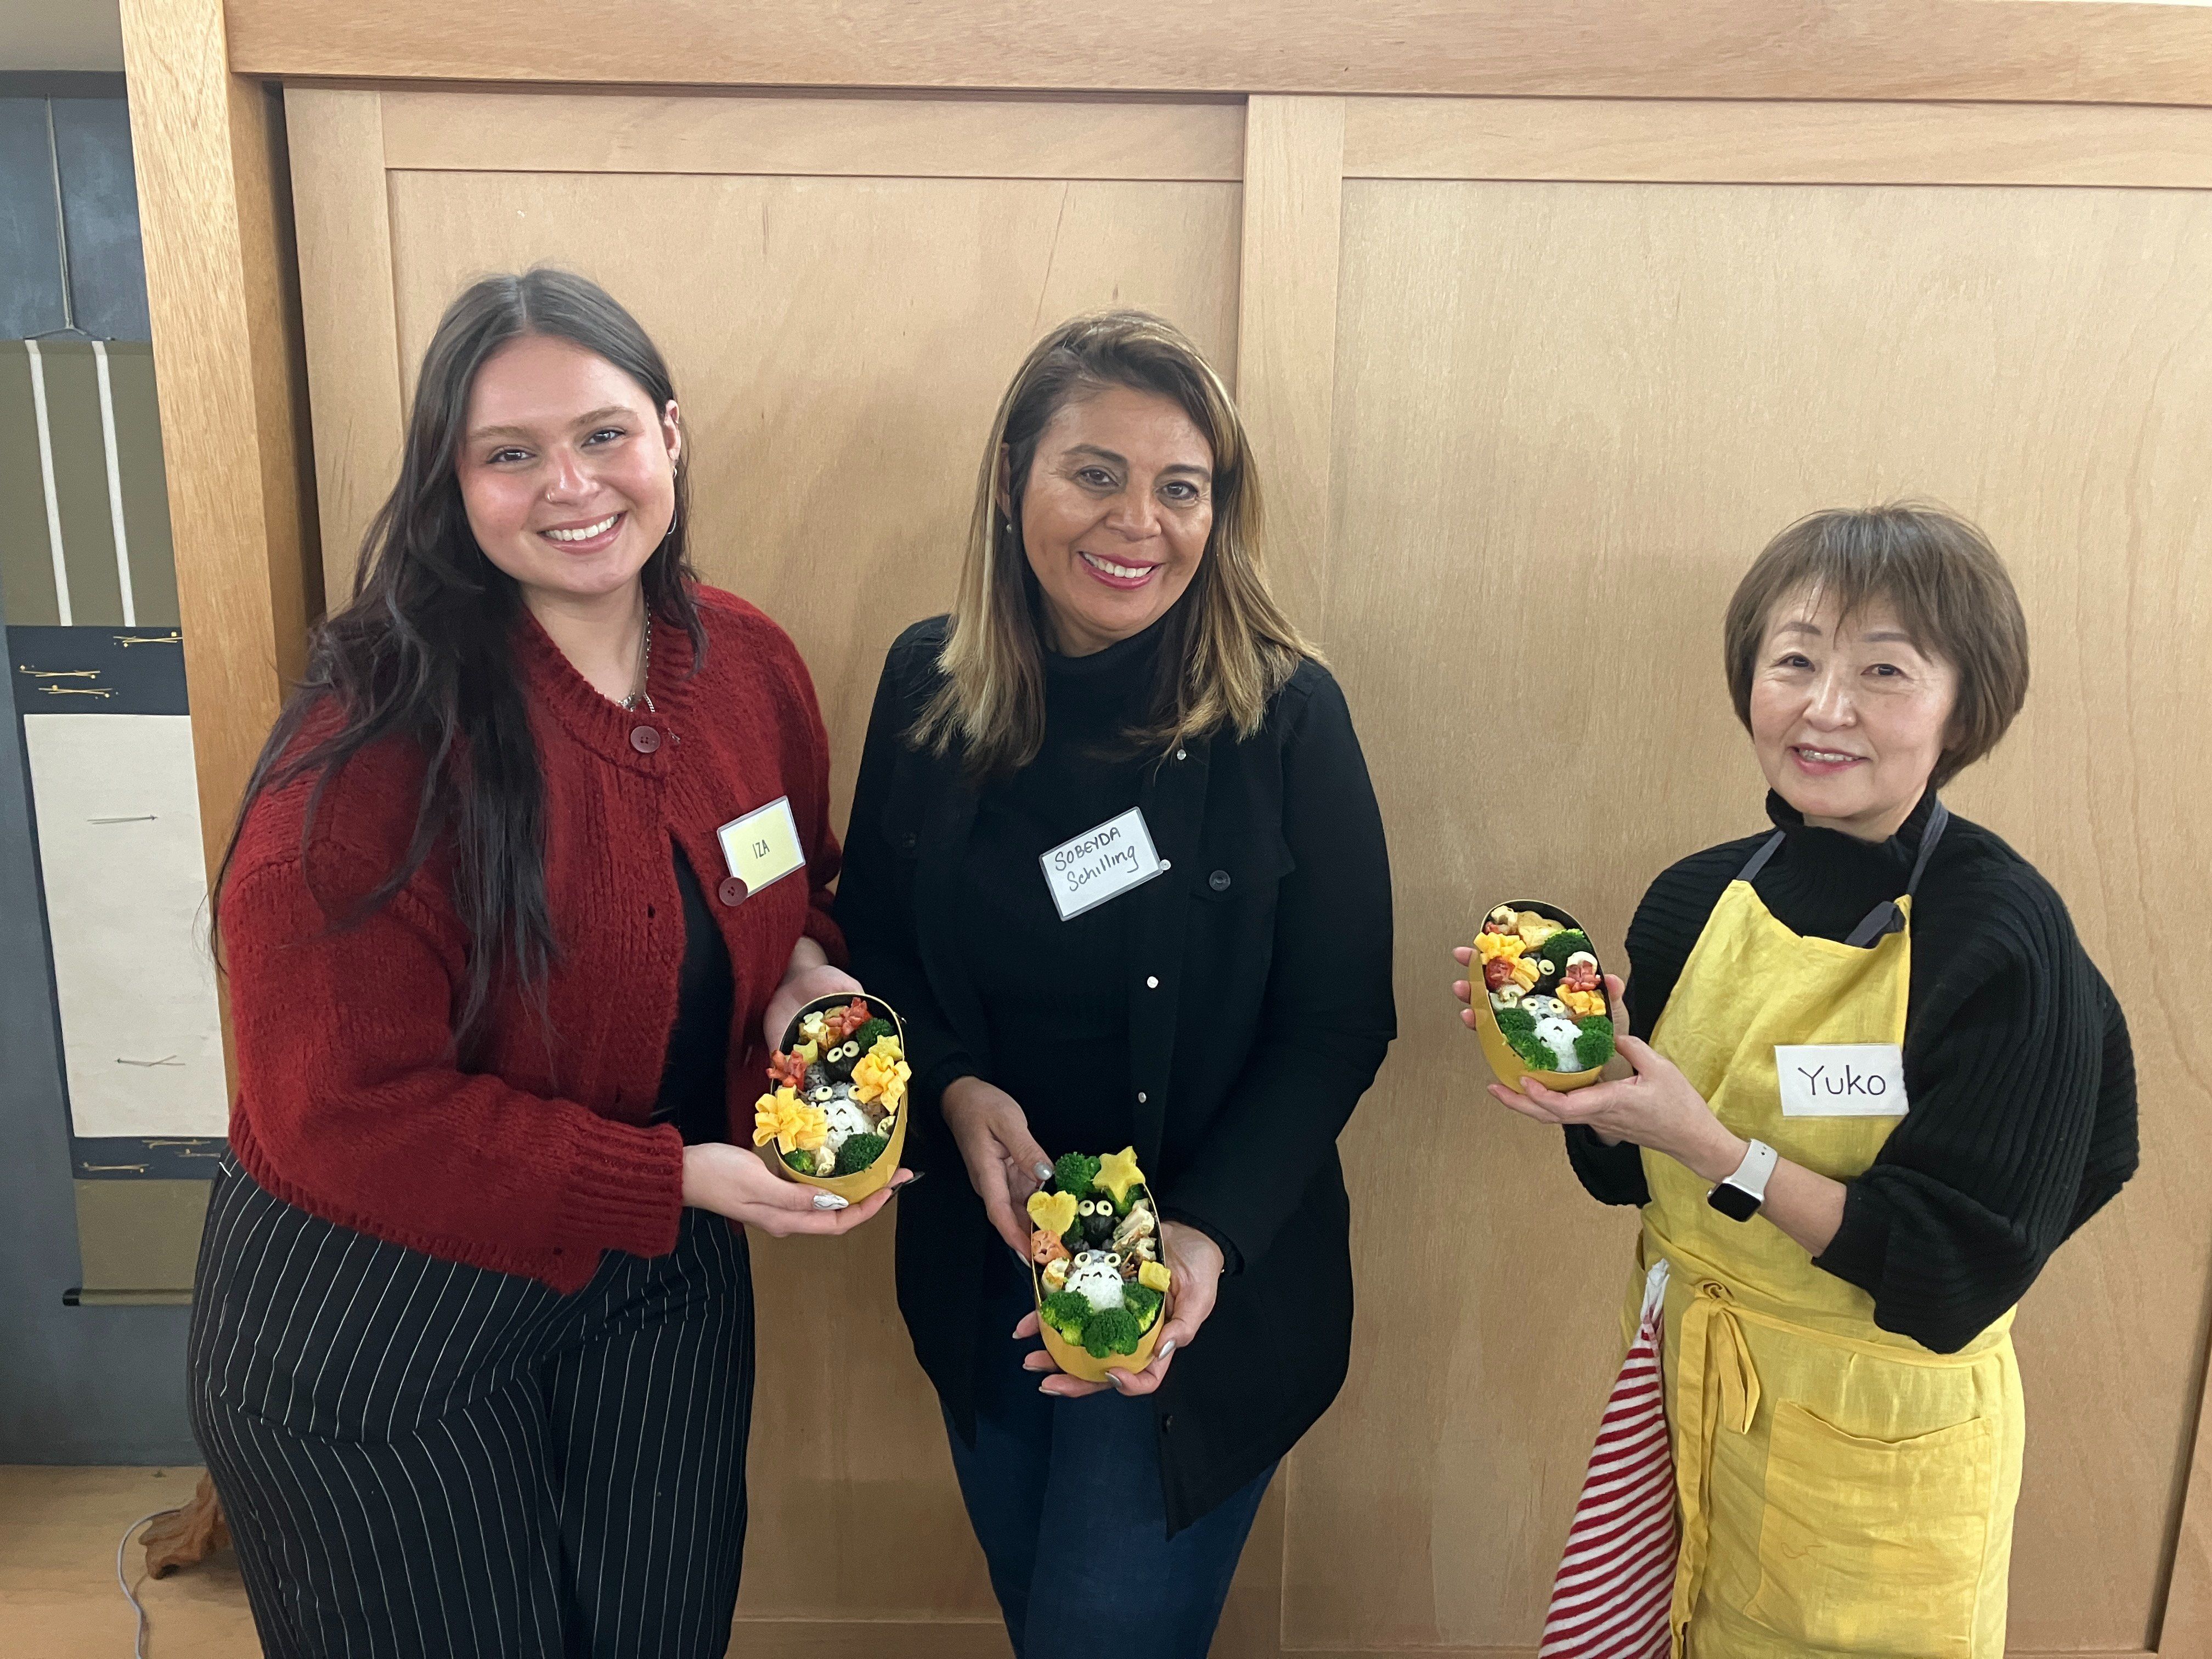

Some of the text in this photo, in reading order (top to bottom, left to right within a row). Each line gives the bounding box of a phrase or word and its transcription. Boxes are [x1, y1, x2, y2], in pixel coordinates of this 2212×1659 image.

[752, 839, 770, 859] IZA
[1054, 827, 1121, 871] SOBEYDA
[1066, 845, 1139, 892] Schilling
[1797, 1064, 1886, 1096] Yuko
